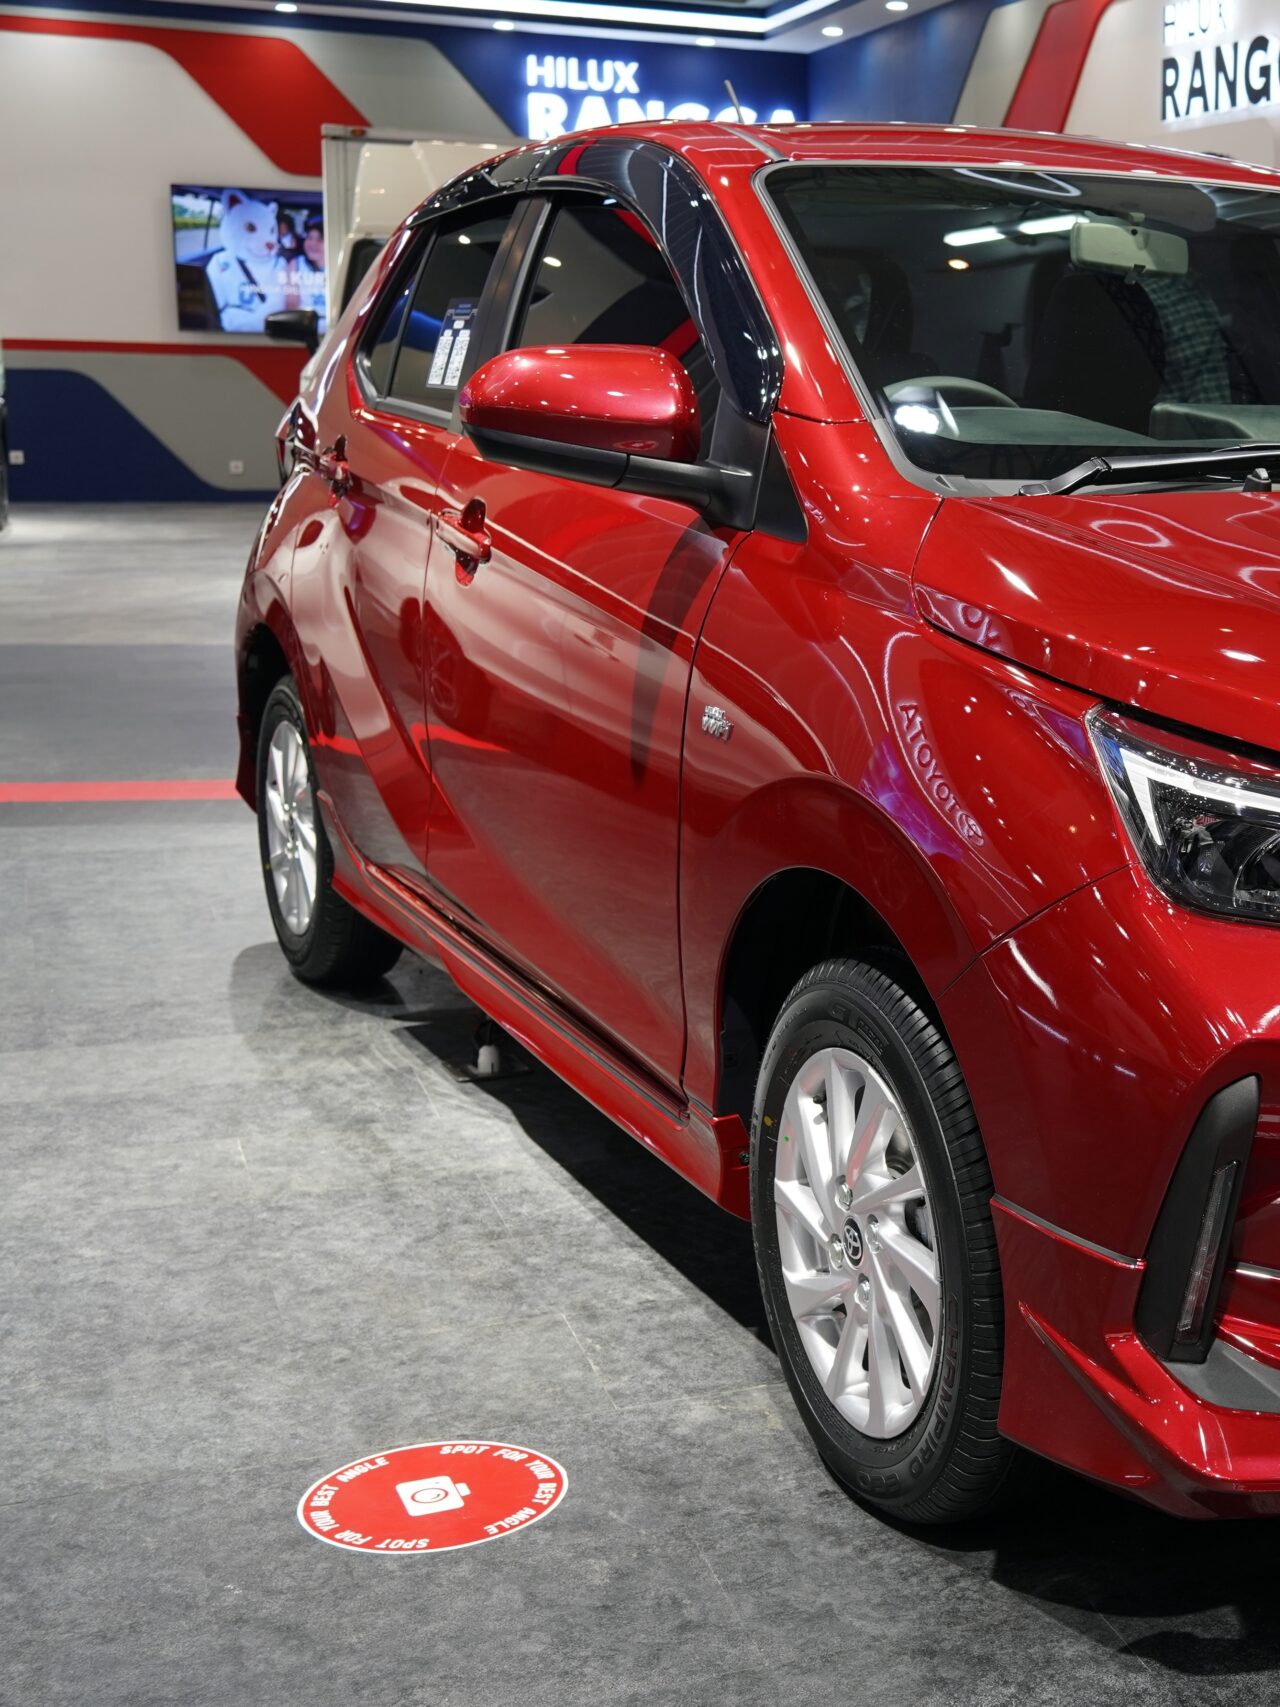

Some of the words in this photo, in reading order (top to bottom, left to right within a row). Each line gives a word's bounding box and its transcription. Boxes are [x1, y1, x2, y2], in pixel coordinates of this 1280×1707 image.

[525, 54, 640, 94] HILUX
[526, 92, 797, 141] RAN
[440, 1445, 491, 1456] SPOT
[493, 1448, 530, 1463] FOR
[336, 1457, 391, 1483] ANGLE
[525, 1459, 557, 1480] YOUR
[310, 1484, 339, 1508] BEST
[531, 1481, 558, 1506] BEST
[310, 1510, 340, 1532] YOUR
[483, 1506, 537, 1536] ANGLE
[334, 1529, 374, 1546] FOR
[374, 1537, 430, 1549] SPOT
